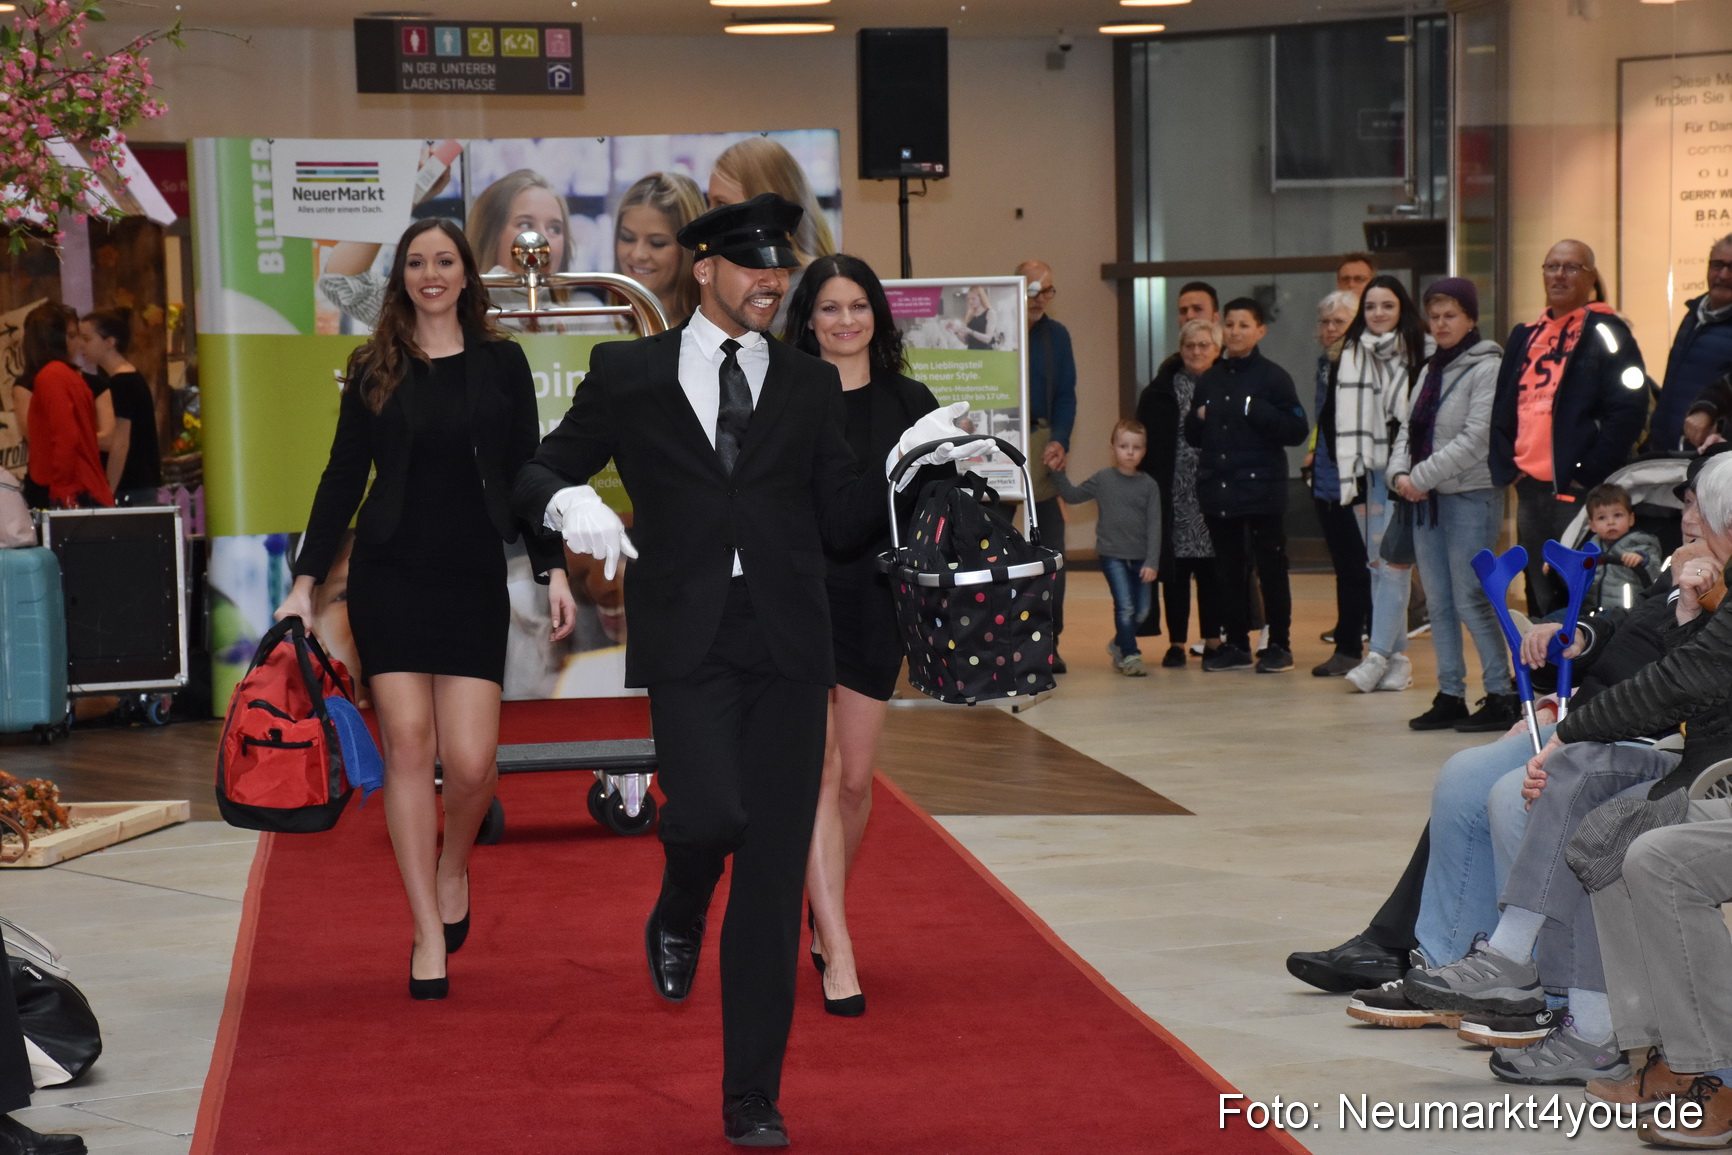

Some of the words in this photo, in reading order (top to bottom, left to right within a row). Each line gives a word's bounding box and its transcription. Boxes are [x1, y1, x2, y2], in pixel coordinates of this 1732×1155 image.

[402, 63, 413, 73] IN
[417, 63, 437, 74] DER
[442, 63, 496, 74] UNTEREN
[403, 79, 496, 90] LADENSTRASSE
[1703, 90, 1724, 104] Sie
[292, 186, 385, 202] NeuerMarkt
[1680, 189, 1716, 201] GERRY
[297, 205, 315, 214] Alles
[316, 206, 336, 214] unter
[337, 206, 361, 214] einem
[362, 205, 383, 214] Dach.
[930, 360, 983, 371] Lieblingsteil
[915, 373, 928, 381] bis
[929, 373, 954, 381] neuer
